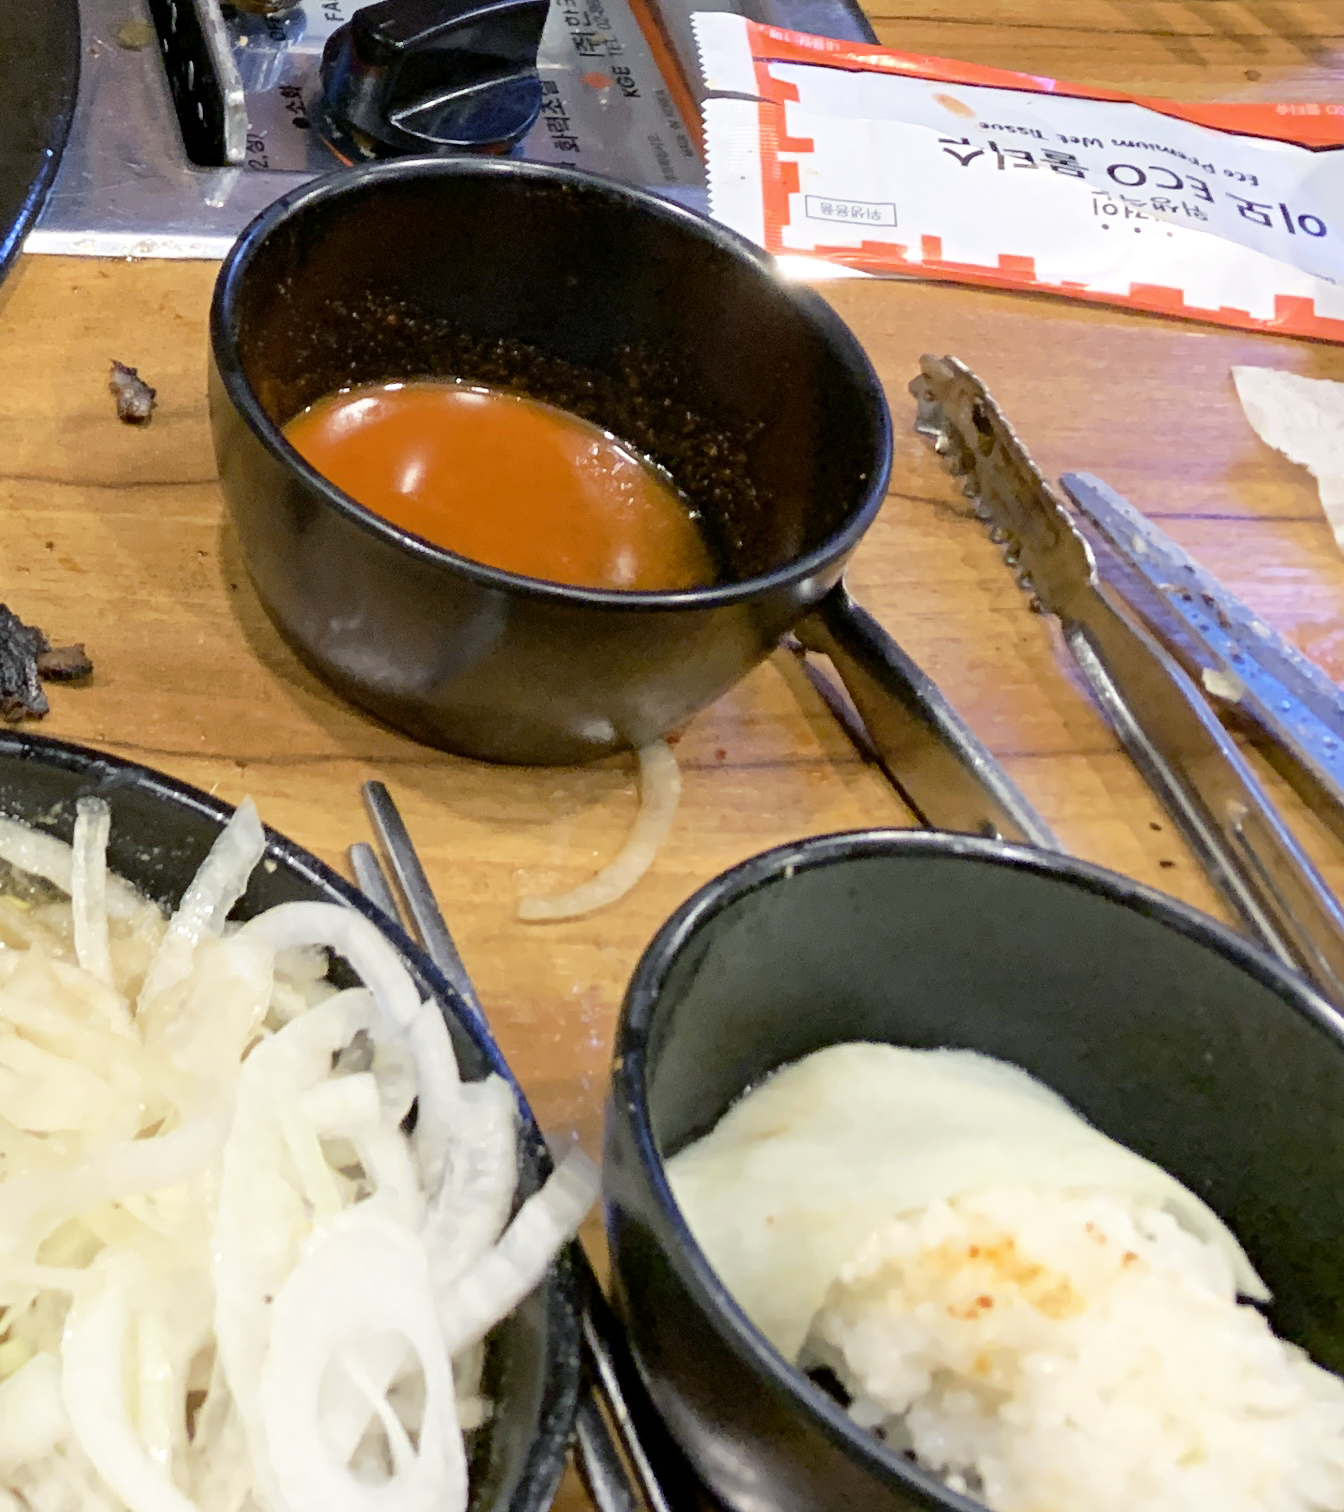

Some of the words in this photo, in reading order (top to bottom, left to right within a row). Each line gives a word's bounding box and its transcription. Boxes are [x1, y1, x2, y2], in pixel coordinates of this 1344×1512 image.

[612, 65, 641, 97] KGE
[978, 121, 1048, 140] Tissue
[1056, 133, 1104, 149] Wet
[1111, 138, 1216, 174] Premium
[1107, 164, 1214, 204] ECO
[1223, 168, 1259, 187] Eco
[1225, 192, 1327, 237] 이모
